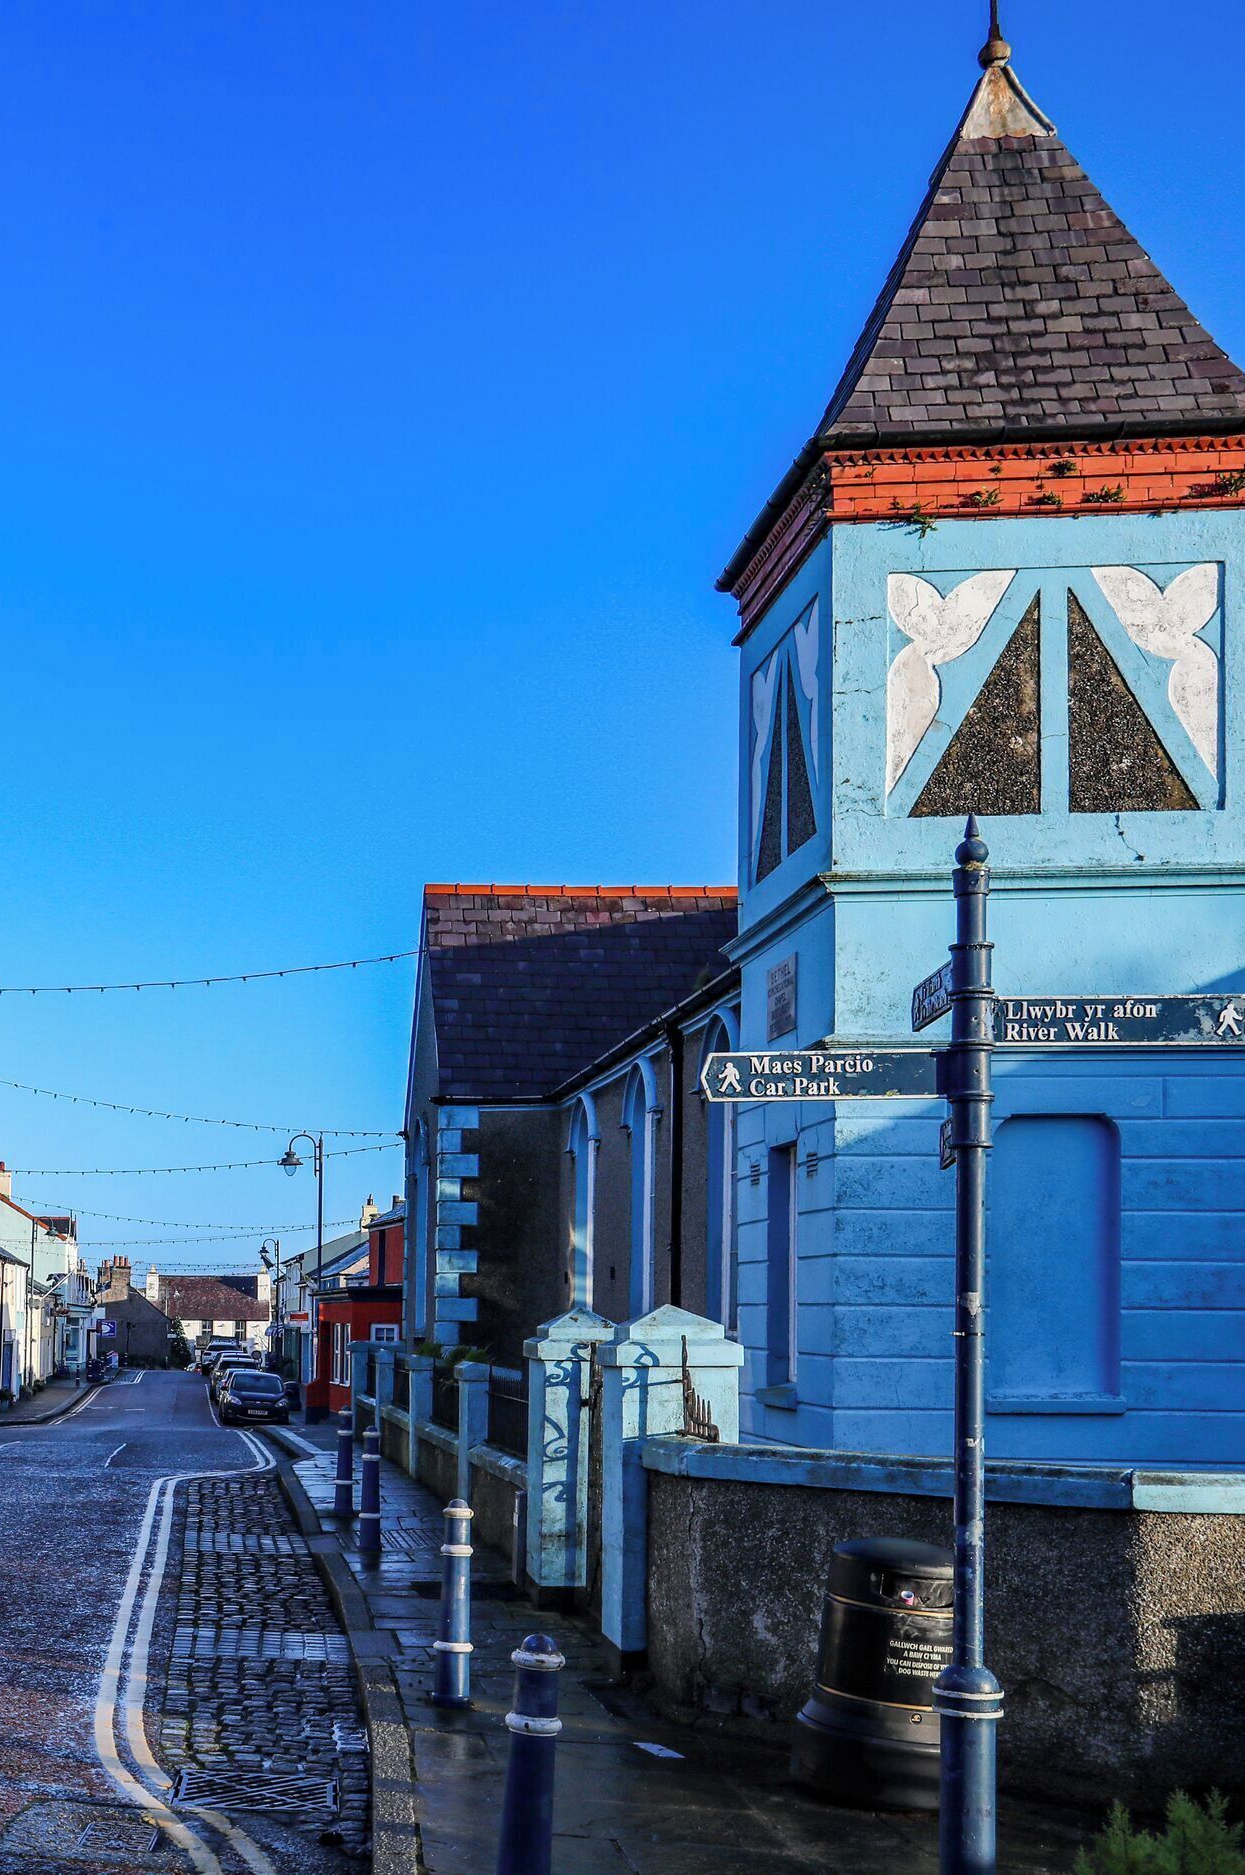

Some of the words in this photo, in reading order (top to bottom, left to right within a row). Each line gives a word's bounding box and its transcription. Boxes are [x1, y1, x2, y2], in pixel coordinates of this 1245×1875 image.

[1005, 1001, 1076, 1022] Llwybr
[1084, 1005, 1105, 1021] yr
[1113, 1000, 1157, 1018] afon
[1005, 1022, 1058, 1040] River
[1065, 1022, 1119, 1040] Walk
[750, 1056, 802, 1074] Maes
[809, 1055, 873, 1073] Parcio
[750, 1079, 786, 1096] Car
[794, 1077, 840, 1095] Park
[890, 1640, 918, 1650] GALLWCH
[909, 1651, 923, 1659] BAW
[887, 1657, 898, 1665] YOU
[912, 1661, 933, 1670] DISPOSE
[898, 1667, 911, 1675] DOG
[912, 1669, 929, 1677] WASTE
